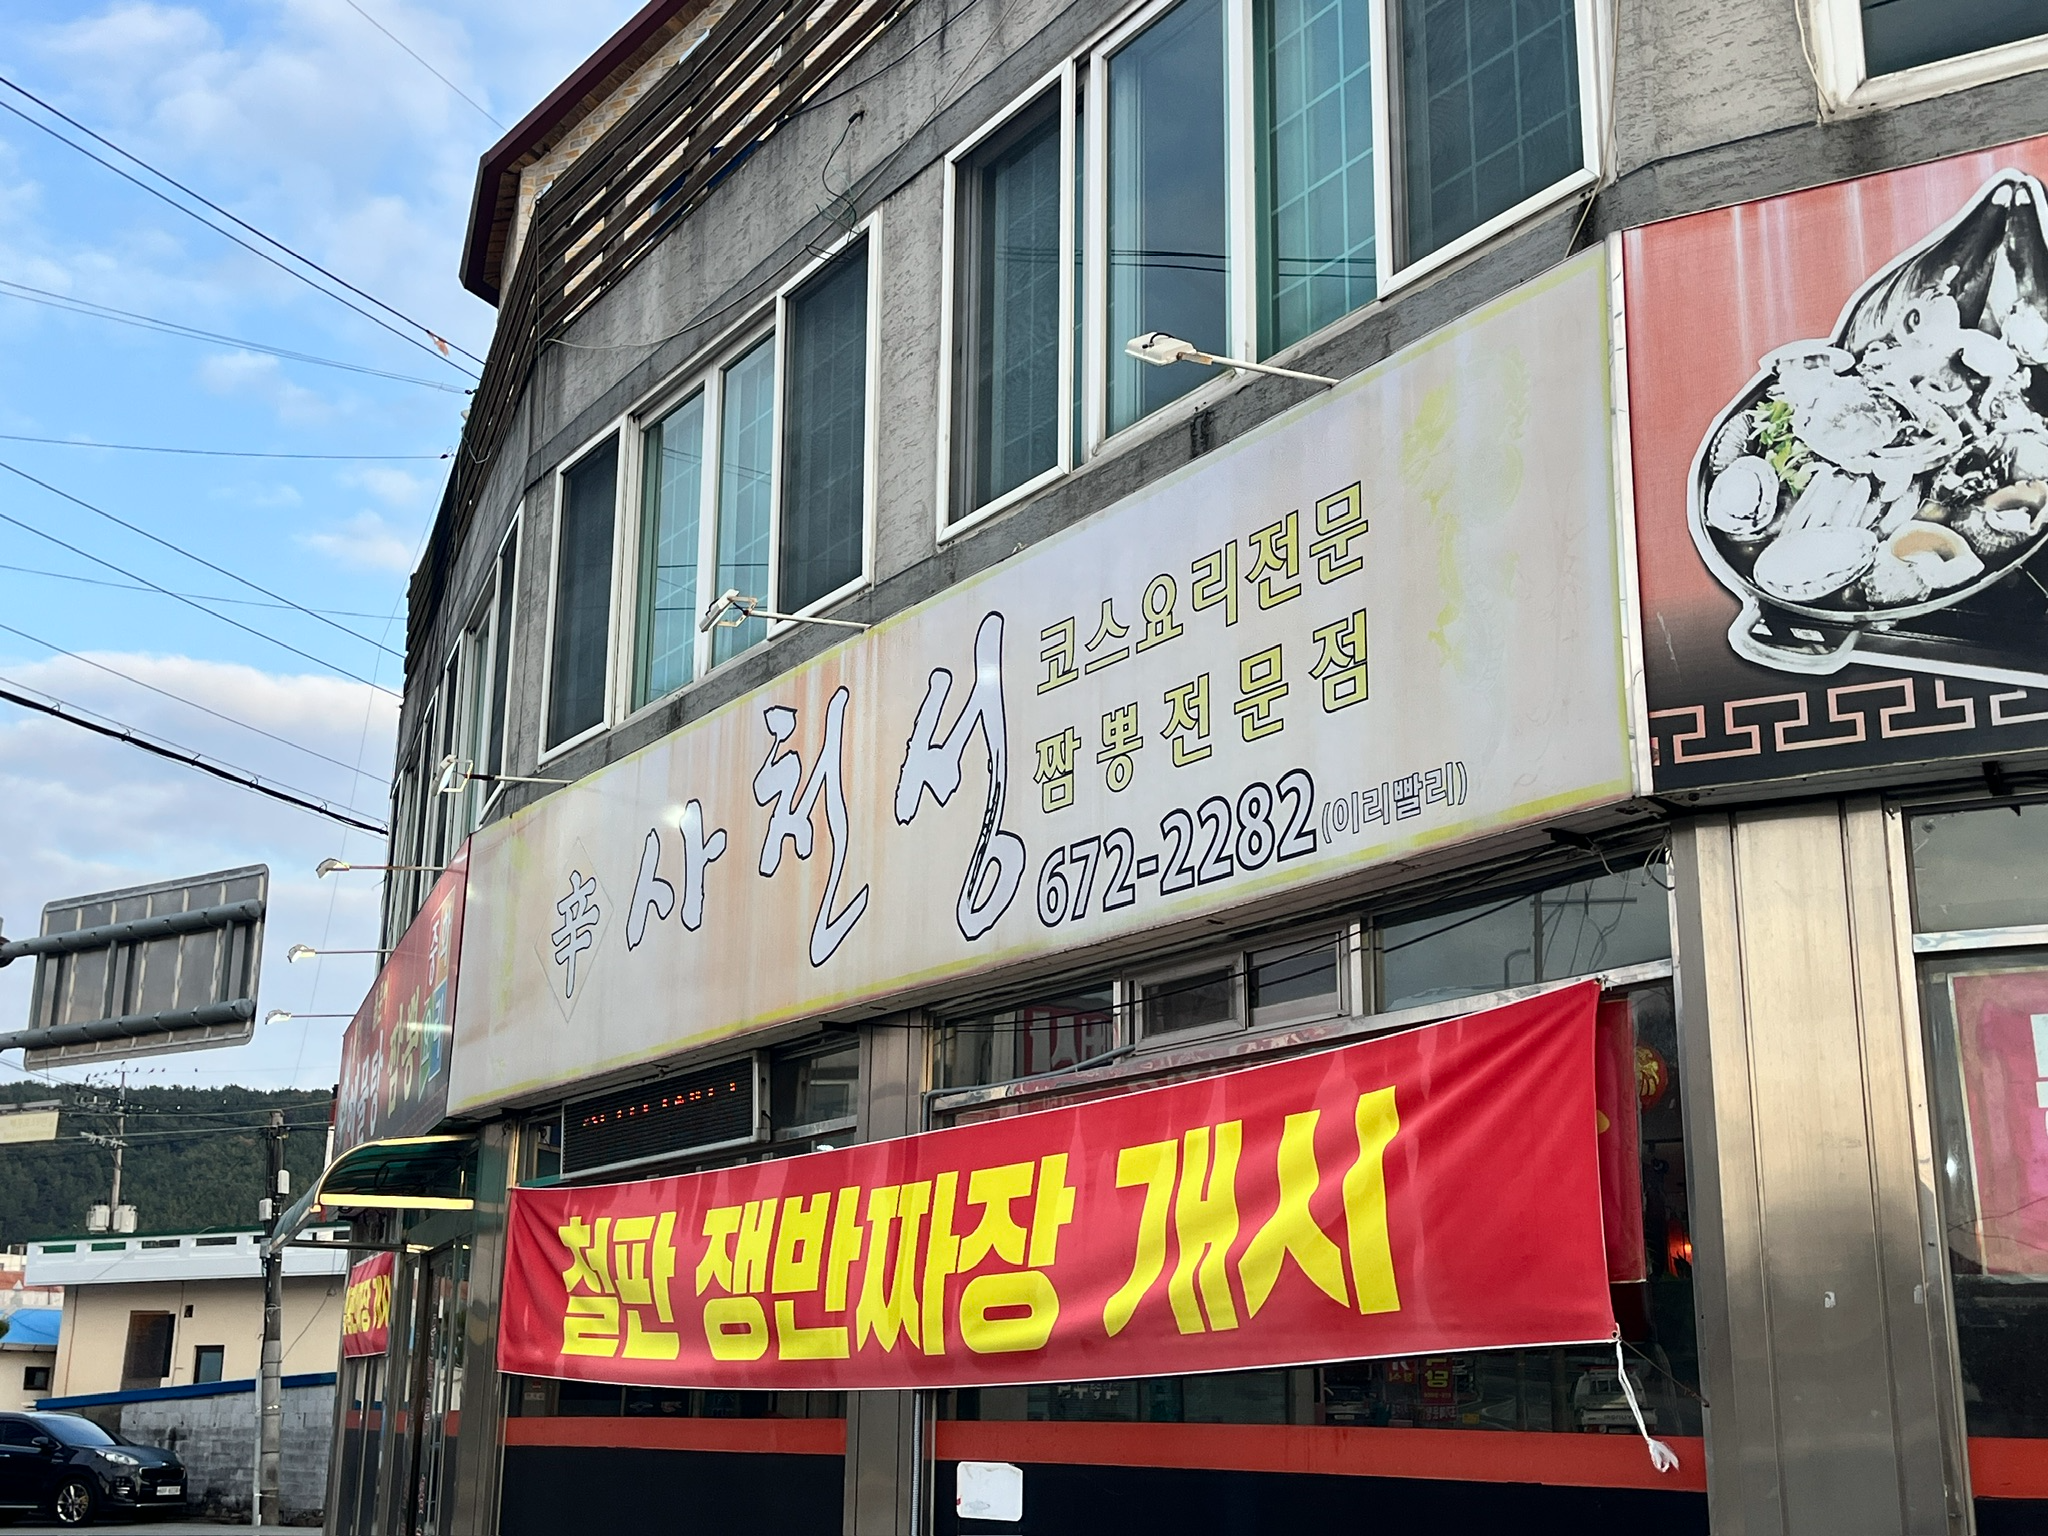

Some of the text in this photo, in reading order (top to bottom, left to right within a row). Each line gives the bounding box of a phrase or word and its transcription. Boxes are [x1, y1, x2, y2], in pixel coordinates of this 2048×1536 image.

[1037, 480, 1368, 695] 코스요리전문
[1033, 608, 1369, 814] 짬뽕전문점
[551, 870, 600, 999] 辛
[1037, 768, 1317, 927] 672-2282
[559, 1085, 1400, 1360] 철판 쟁반짜장 개시
